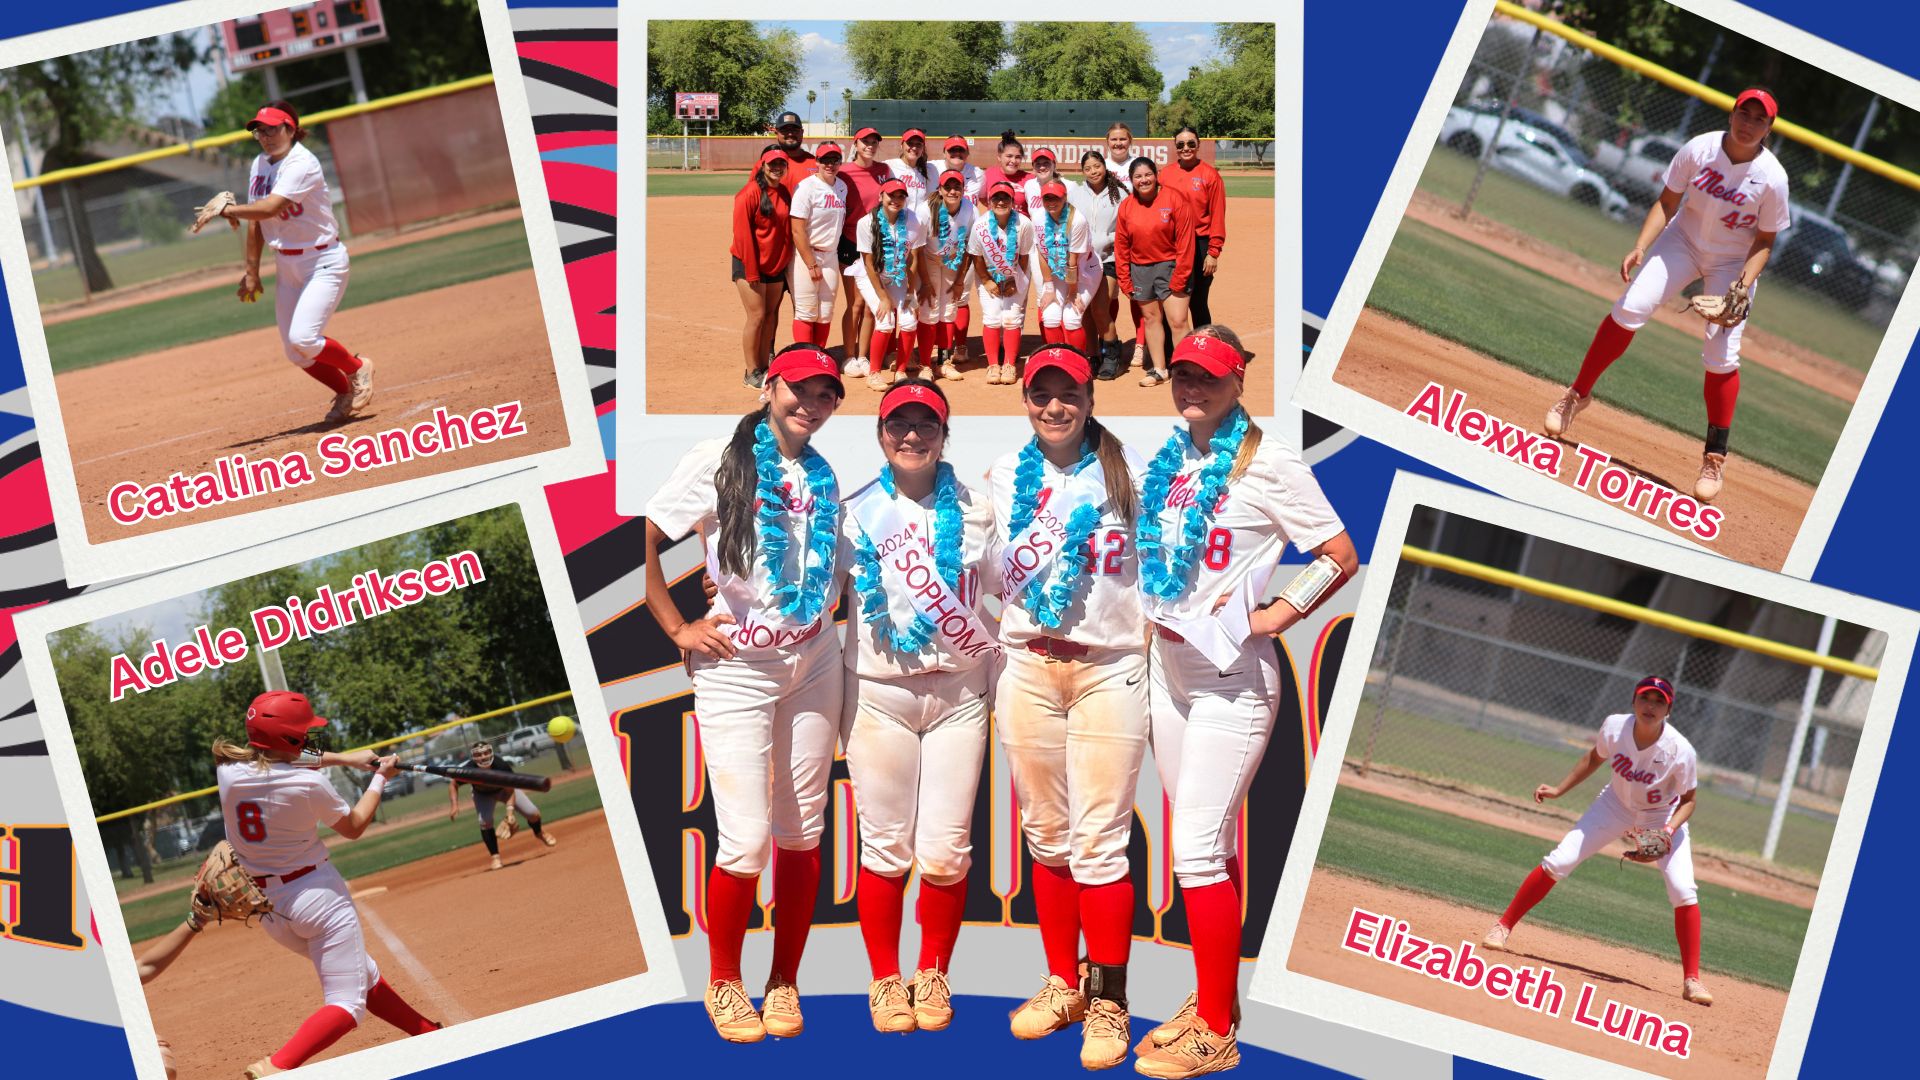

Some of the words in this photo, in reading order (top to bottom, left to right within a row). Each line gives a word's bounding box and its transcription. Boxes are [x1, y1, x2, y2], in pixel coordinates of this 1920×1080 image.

[1693, 167, 1747, 206] Mesa
[1720, 210, 1758, 231] 42
[877, 527, 912, 557] 2024
[1037, 509, 1067, 542] 2024
[1204, 527, 1233, 572] 8
[1611, 752, 1657, 785] Mesa
[1646, 789, 1662, 804] 6
[235, 800, 267, 842] 8
